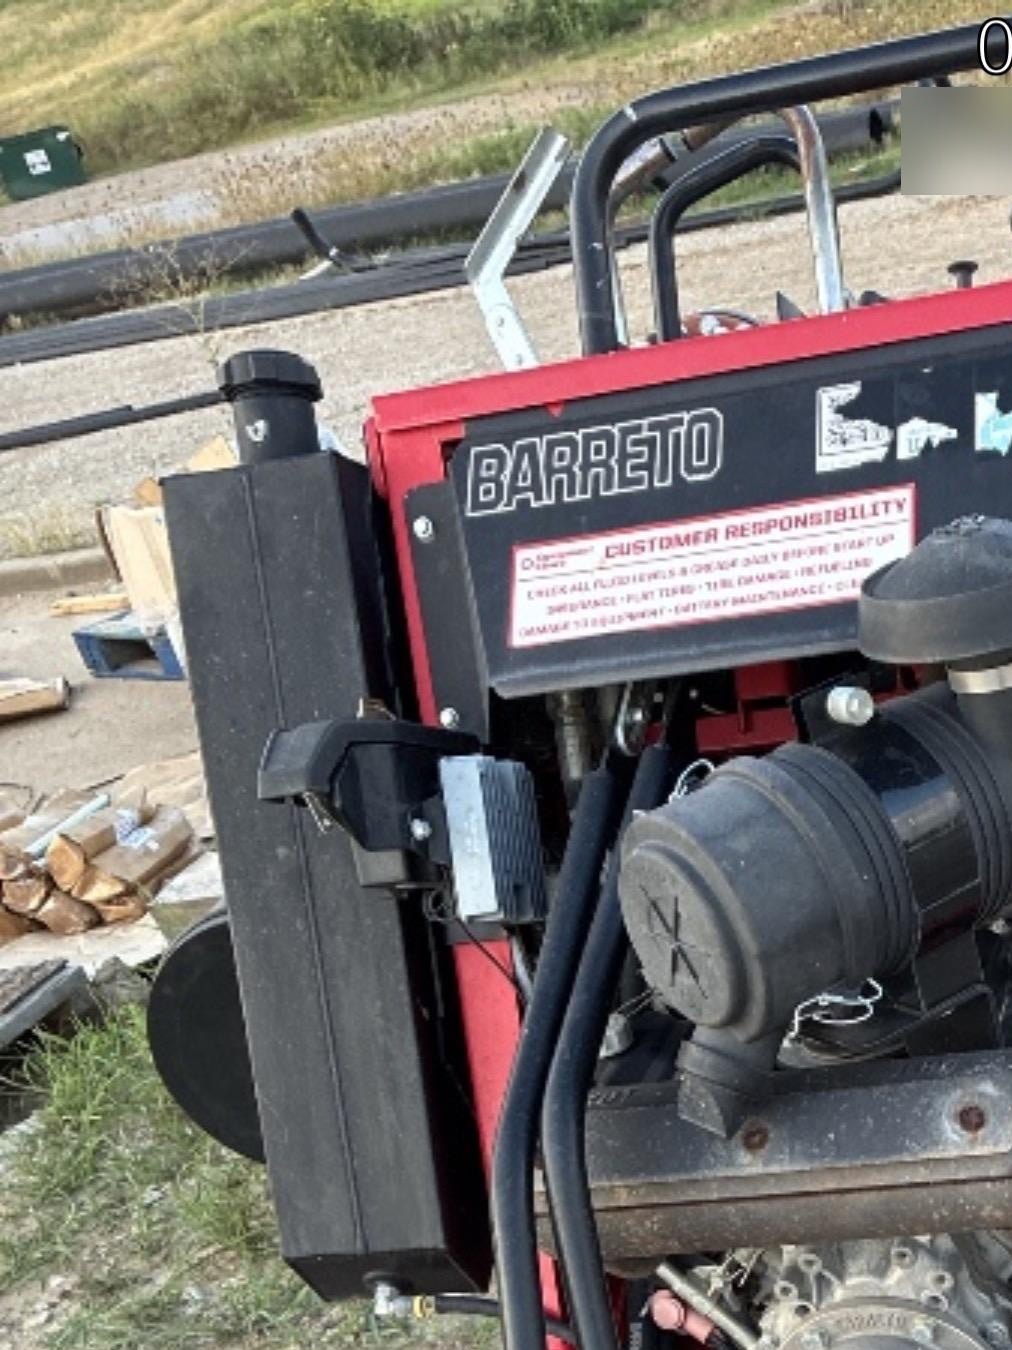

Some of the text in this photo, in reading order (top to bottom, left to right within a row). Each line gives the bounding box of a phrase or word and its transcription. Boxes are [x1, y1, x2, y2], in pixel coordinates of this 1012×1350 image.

[465, 406, 723, 518] BARRETO
[604, 498, 907, 559] CUSTOMER RESPONSIBILITY
